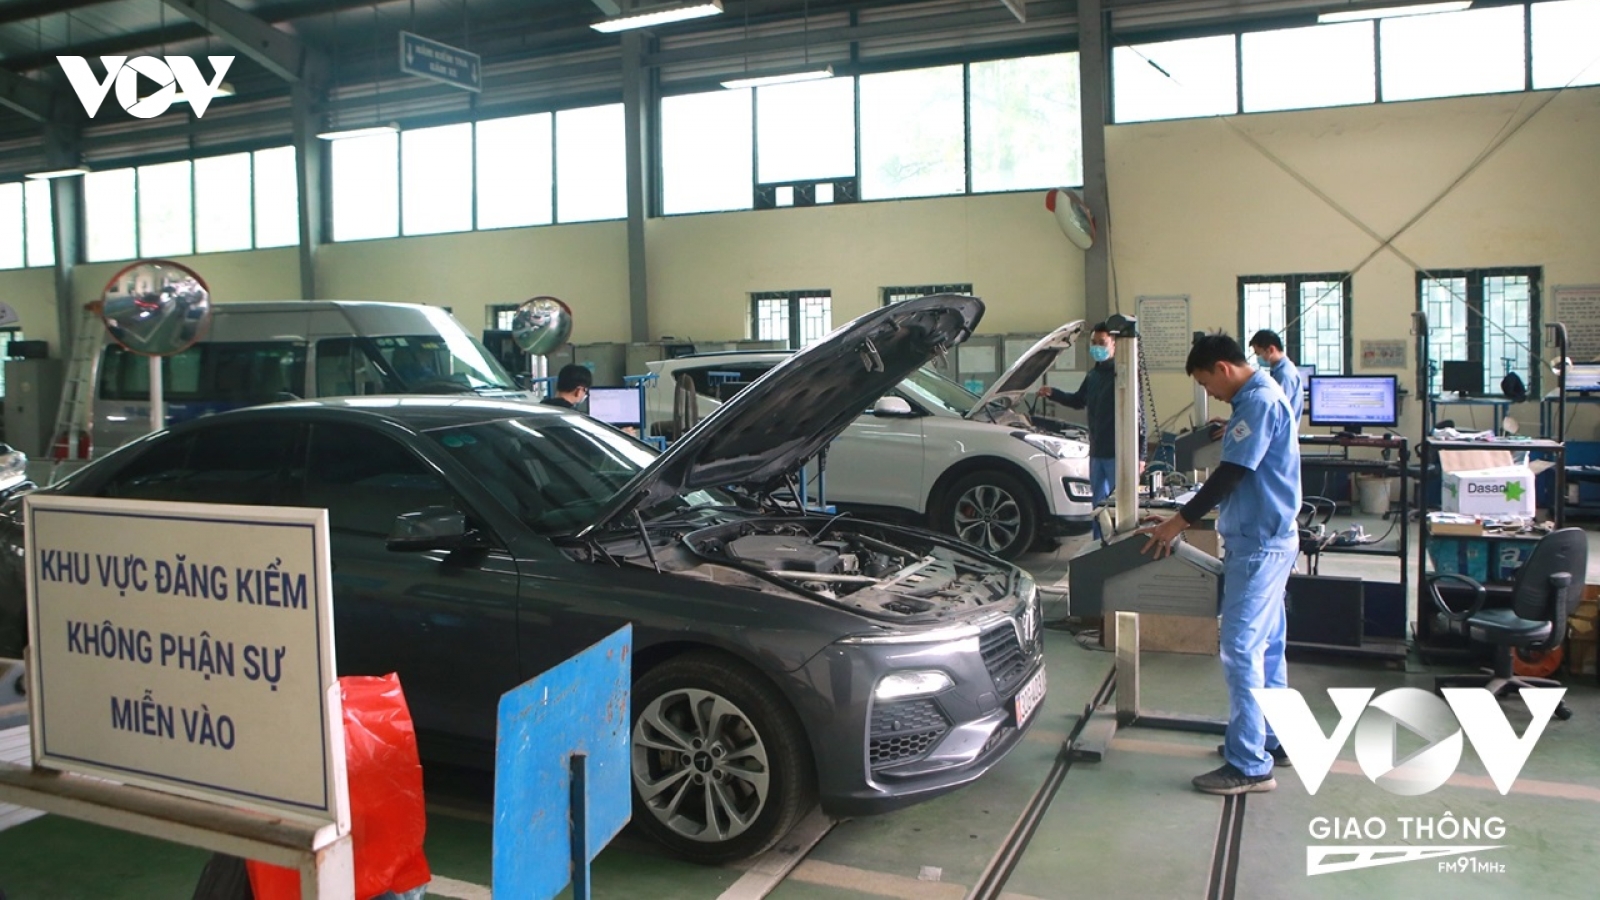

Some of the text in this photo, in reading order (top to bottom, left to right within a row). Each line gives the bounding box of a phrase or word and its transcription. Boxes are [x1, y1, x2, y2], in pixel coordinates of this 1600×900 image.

[41, 549, 308, 609] KHU VỰC ĐĂNG KIỂM
[67, 620, 286, 691] KHÔNG PHẬN SỰ
[111, 690, 236, 750] MIỄN VÀO
